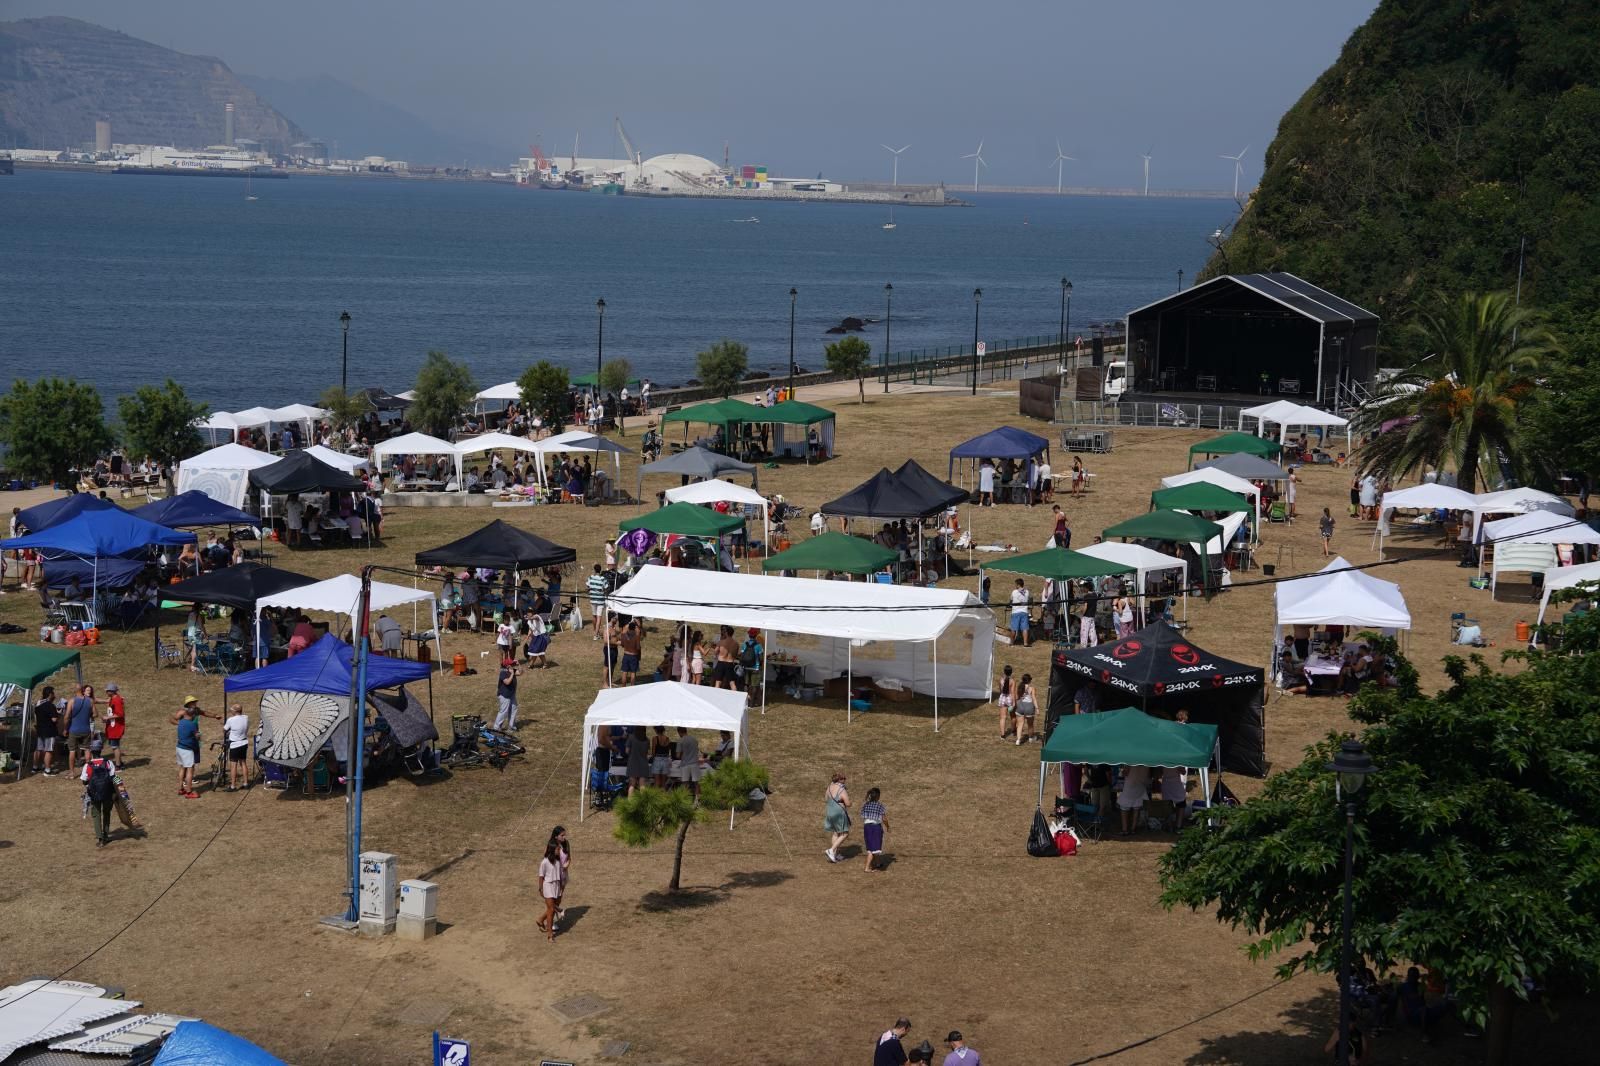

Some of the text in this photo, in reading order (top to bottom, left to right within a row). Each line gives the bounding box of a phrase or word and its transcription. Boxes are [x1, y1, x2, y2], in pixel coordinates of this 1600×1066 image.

[1066, 660, 1093, 676] 24MX
[1093, 653, 1127, 669] 24MX
[1177, 663, 1217, 674] 24MX
[1111, 676, 1138, 693] 24MX
[1165, 680, 1201, 693] 24MX
[1224, 674, 1257, 685] 24MX
